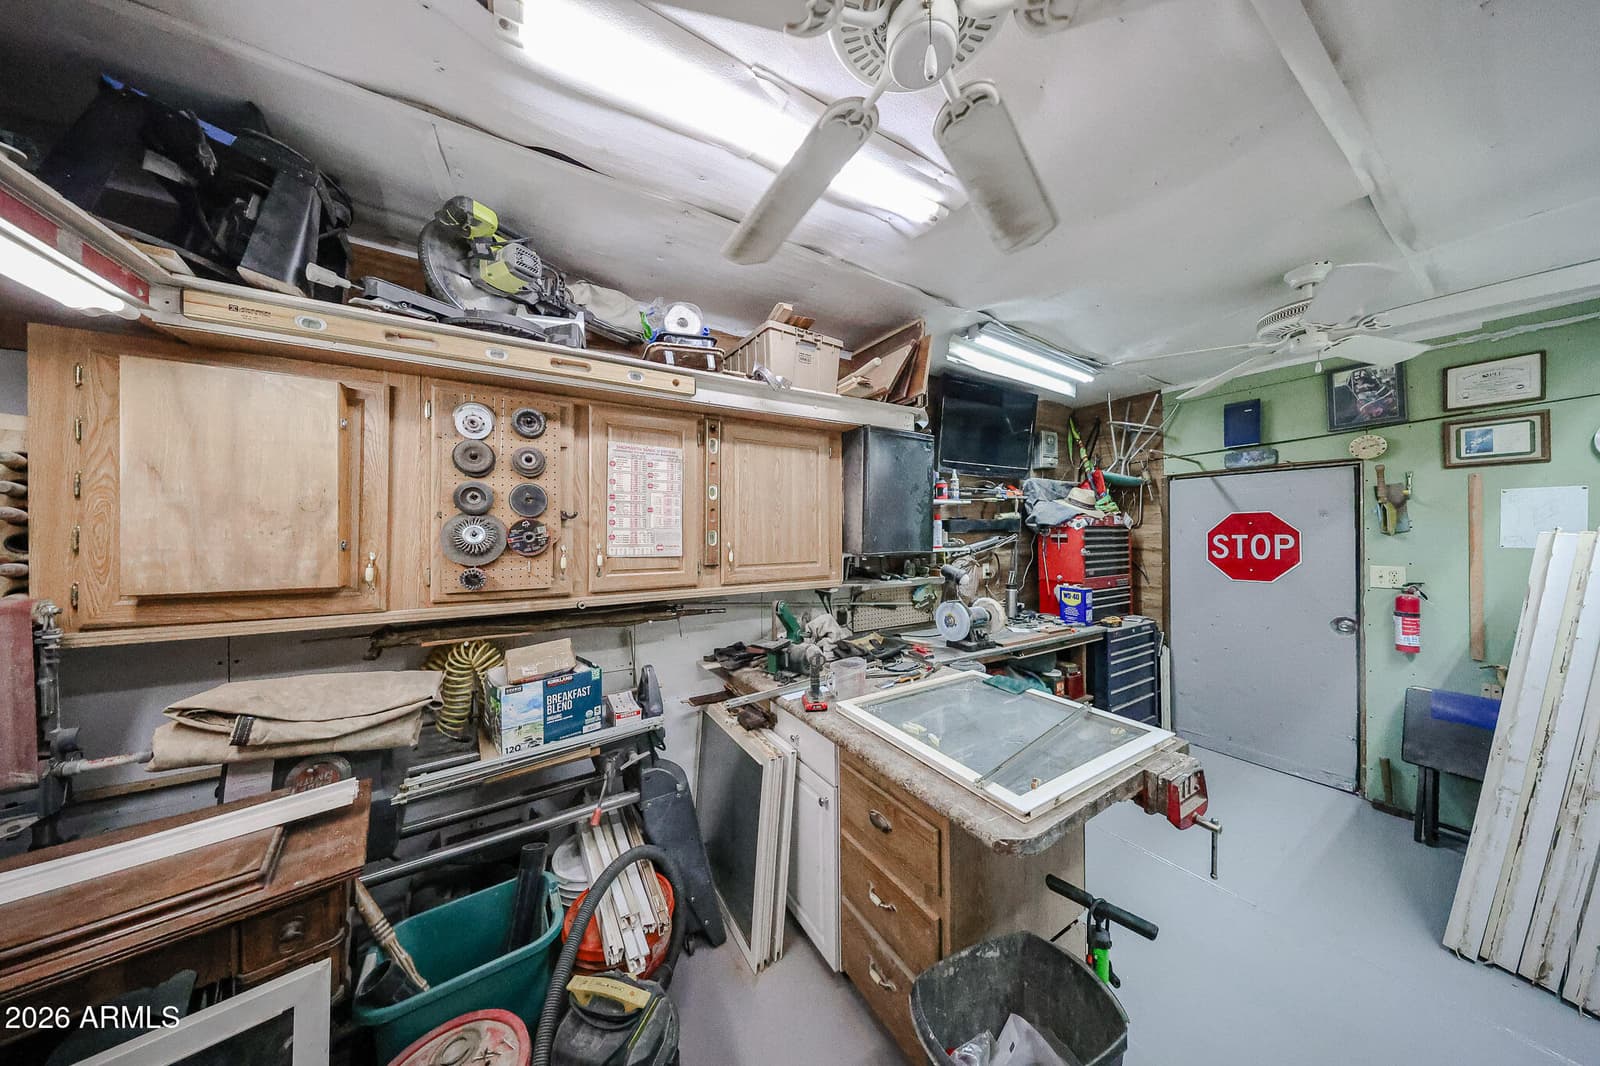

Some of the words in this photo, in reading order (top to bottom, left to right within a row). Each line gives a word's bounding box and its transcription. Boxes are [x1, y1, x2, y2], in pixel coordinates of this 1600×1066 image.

[1211, 533, 1295, 560] STOP
[546, 685, 591, 706] BREAKFAST
[546, 699, 573, 716] BLEND
[505, 744, 521, 755] 120
